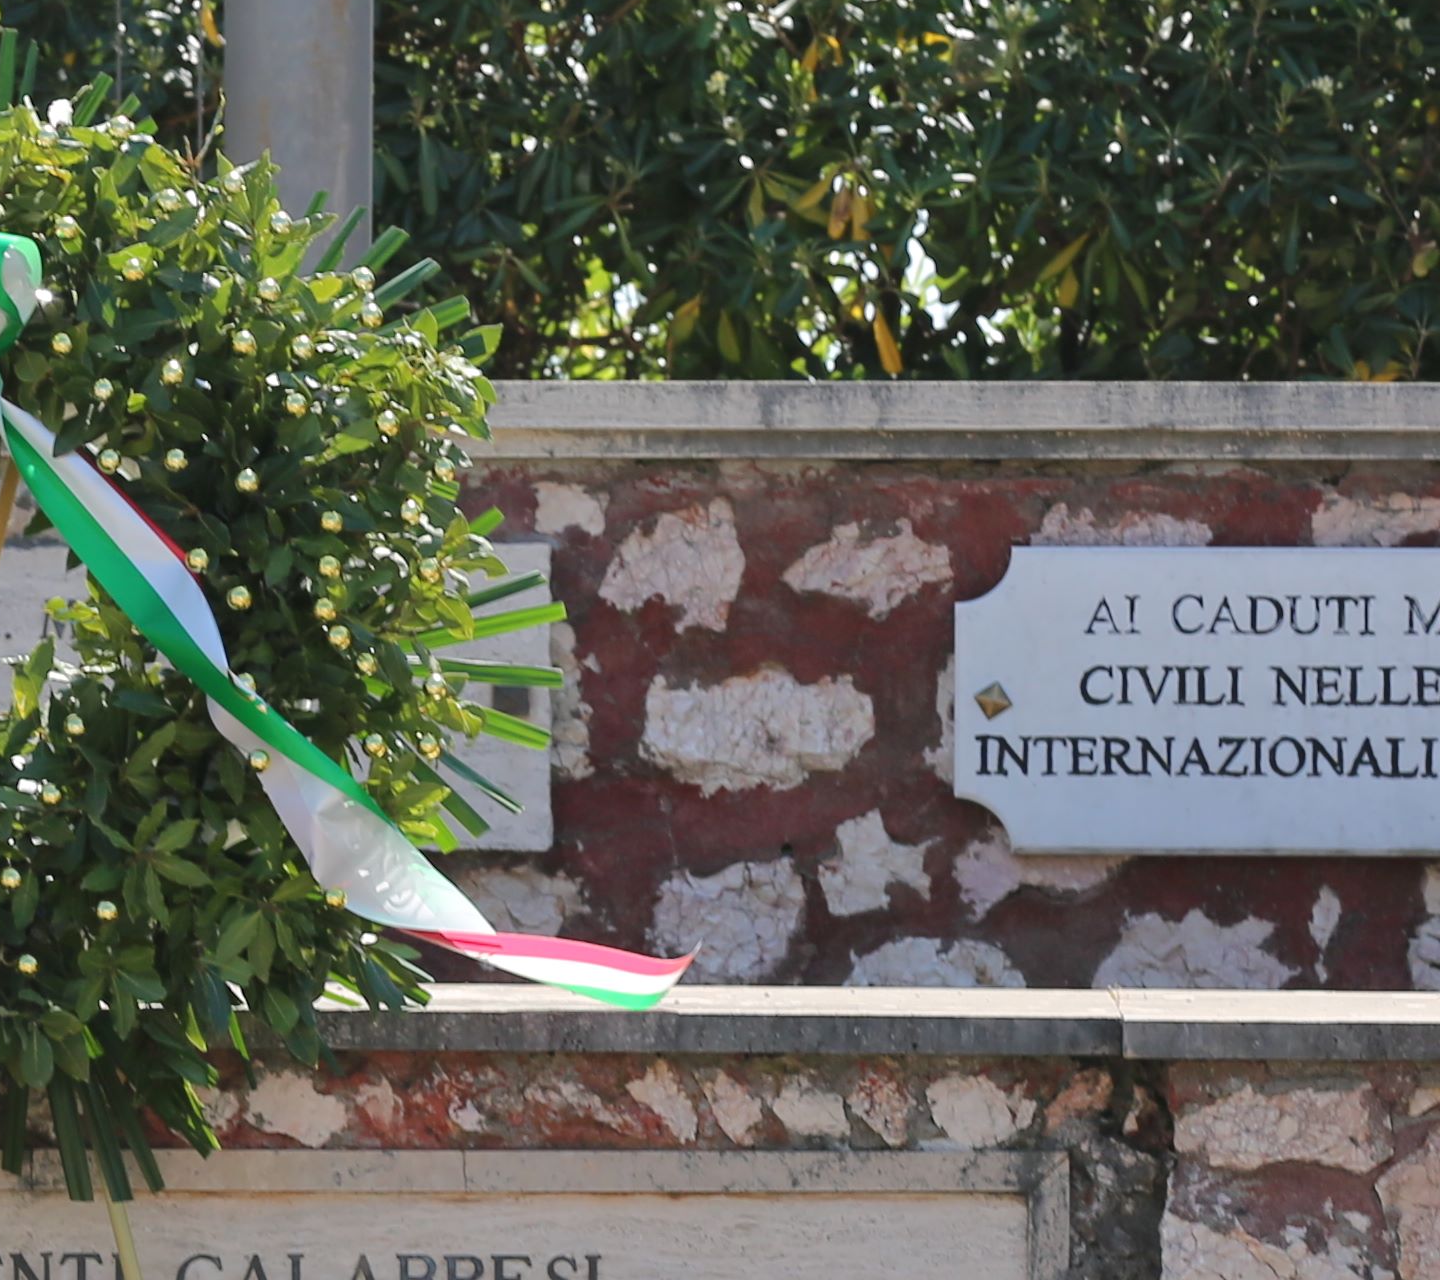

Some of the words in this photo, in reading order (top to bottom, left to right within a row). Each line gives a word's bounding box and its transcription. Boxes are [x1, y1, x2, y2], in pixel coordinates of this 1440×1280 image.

[1084, 595, 1140, 635] AI
[1171, 594, 1376, 637] CADUTI
[1079, 665, 1246, 707] CIVILI
[974, 734, 1439, 780] INTERNAZIONALI
